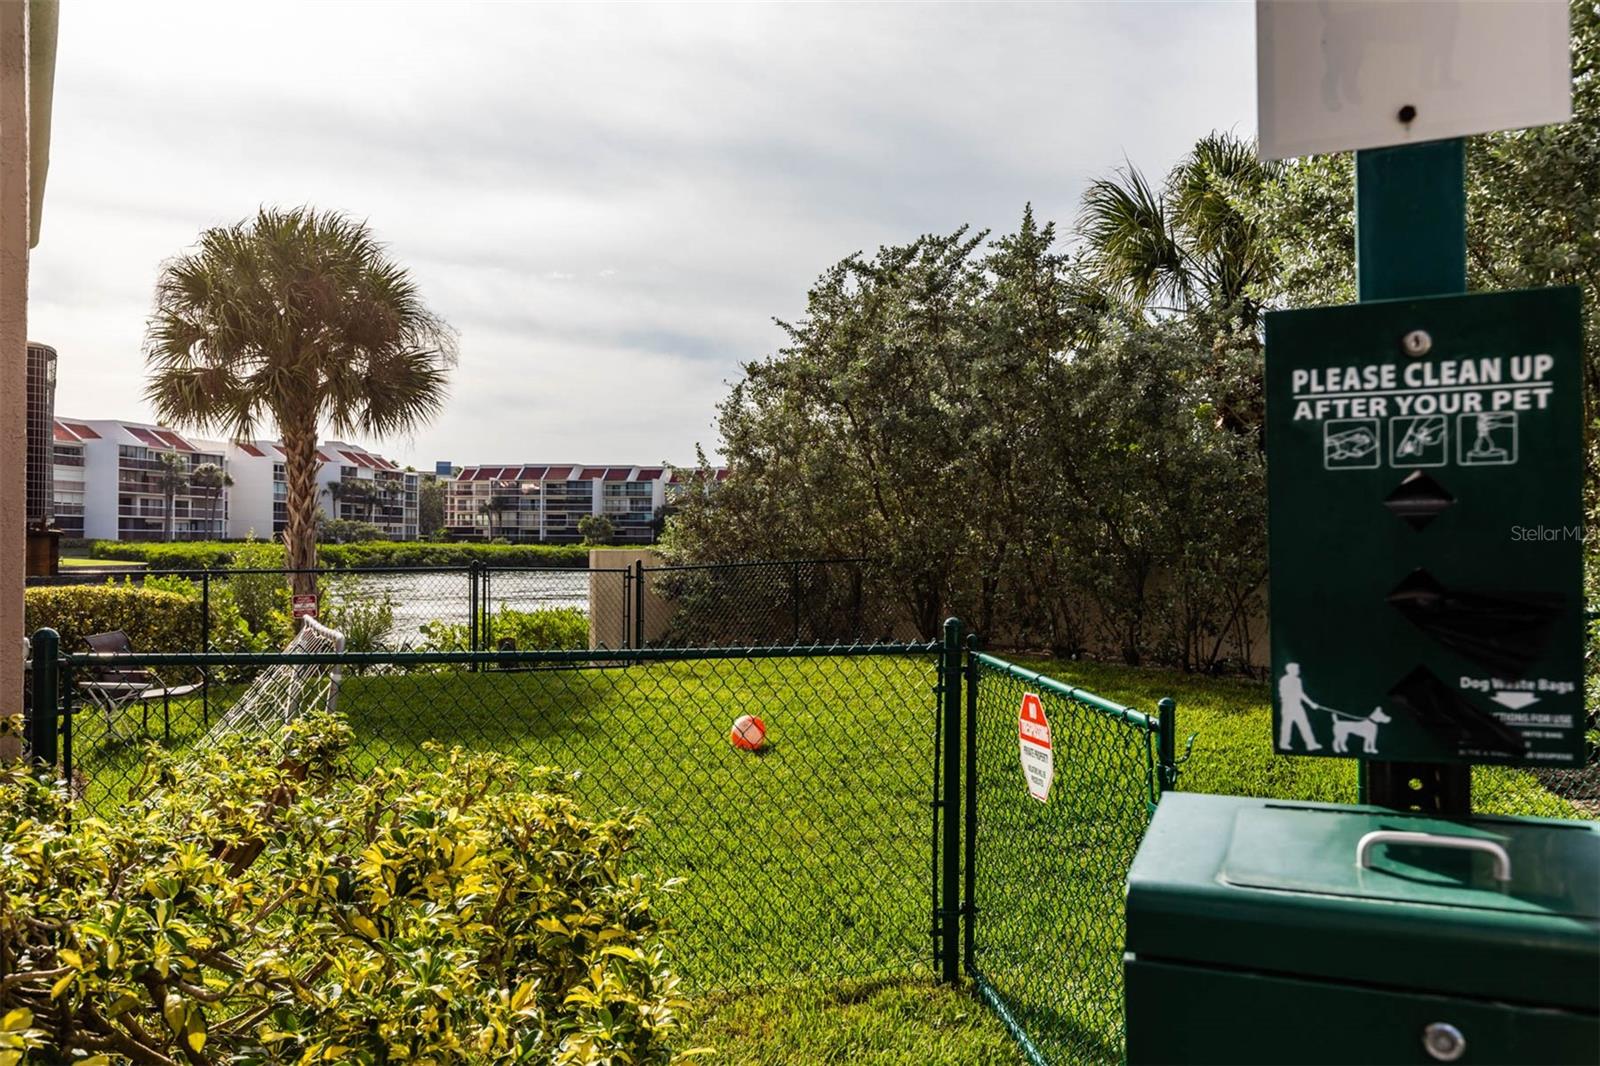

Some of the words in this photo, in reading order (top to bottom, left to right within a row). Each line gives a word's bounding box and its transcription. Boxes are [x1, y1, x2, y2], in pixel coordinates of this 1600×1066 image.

[1292, 364, 1397, 393] PLEASE
[1404, 357, 1501, 387] CLEAN
[1510, 354, 1553, 381] UP
[1293, 397, 1388, 420] AFTER
[1395, 391, 1482, 416] YOUR
[1492, 387, 1553, 412] PET
[1460, 676, 1490, 692] Dog
[1538, 678, 1575, 694] Bags
